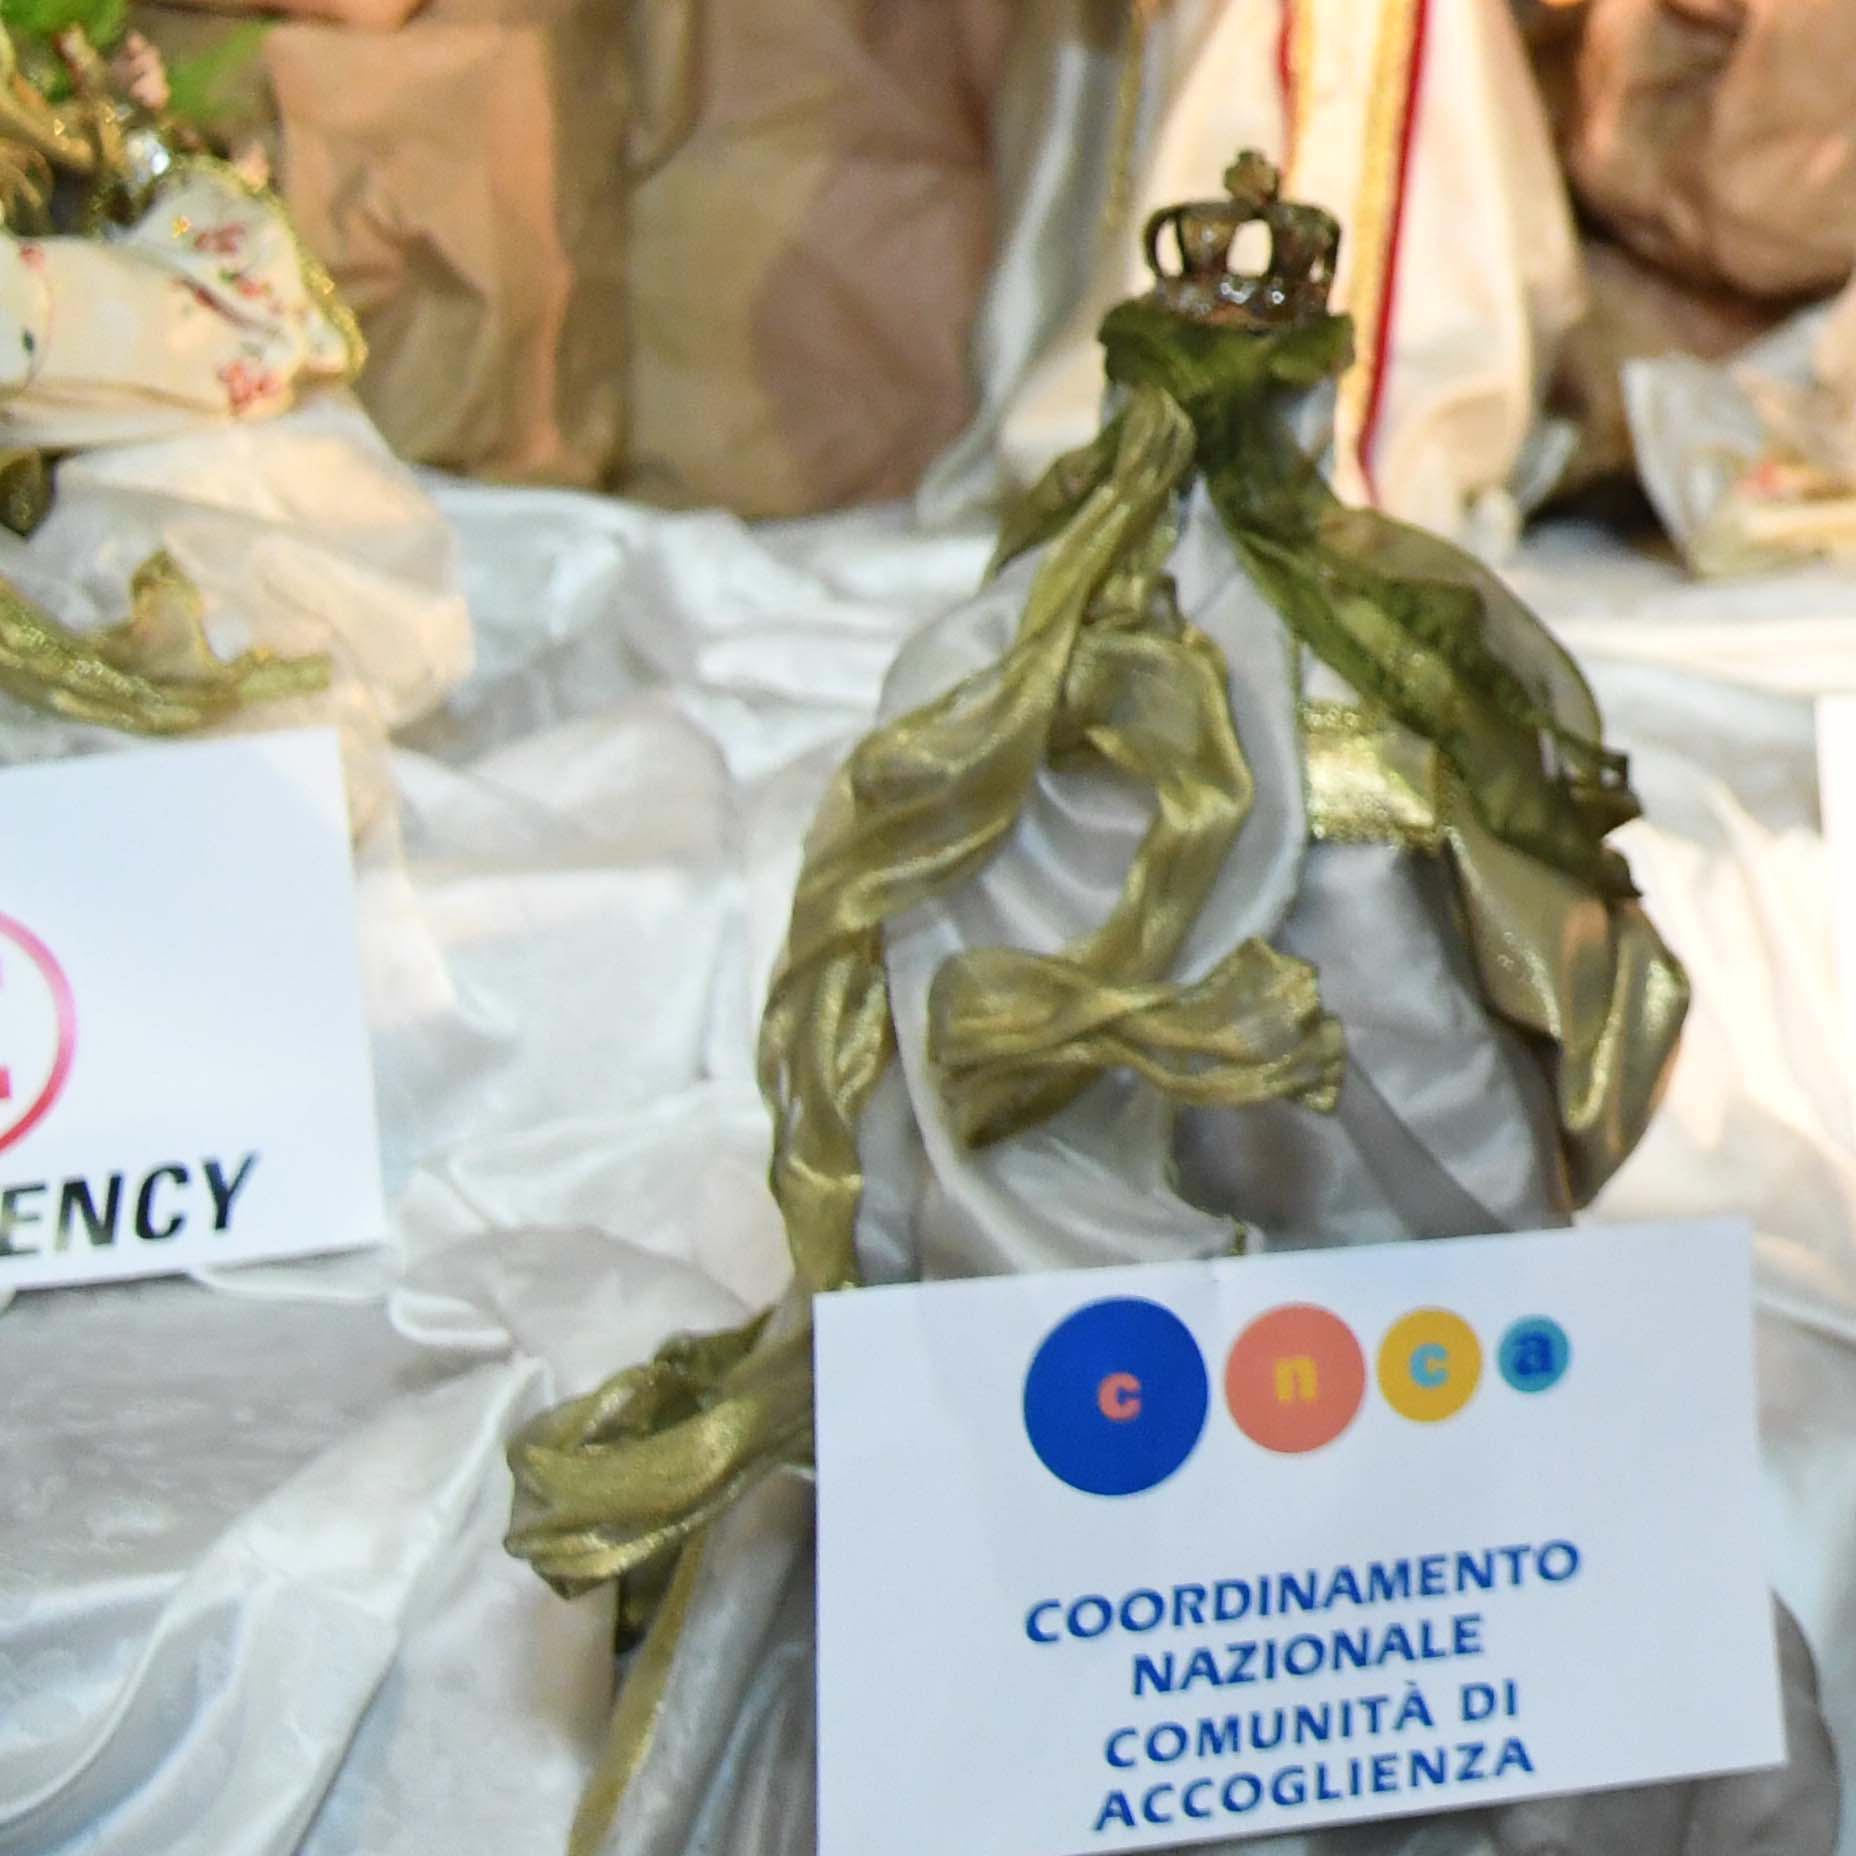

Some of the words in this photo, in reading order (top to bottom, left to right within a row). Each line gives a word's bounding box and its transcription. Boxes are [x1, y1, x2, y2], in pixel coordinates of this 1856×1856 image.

[1023, 1537, 1582, 1645] COORDINAMENTO
[1130, 1613, 1484, 1699] NAZIONALE
[1103, 1680, 1435, 1770] COMUNITÀ
[1460, 1678, 1520, 1724] DI
[1092, 1737, 1537, 1833] ACCOGLIENZA
